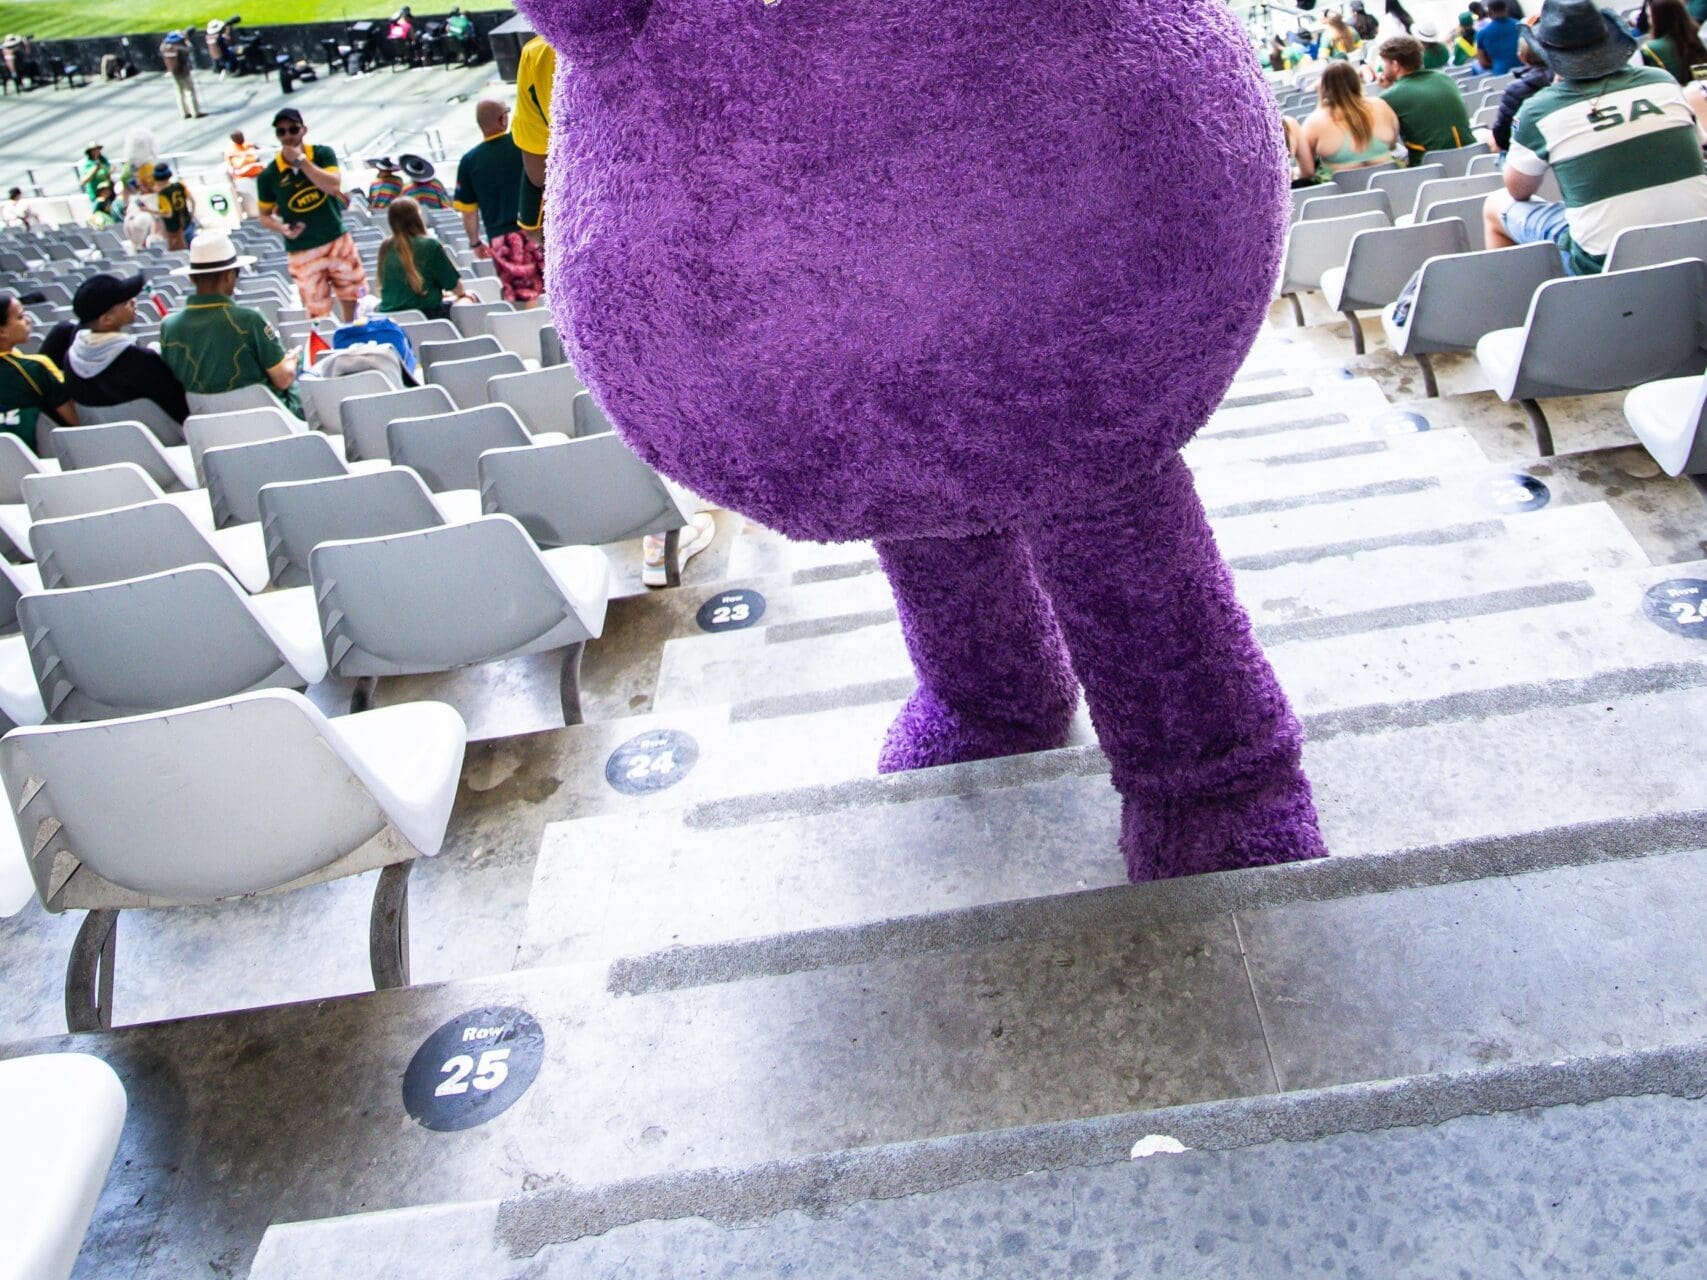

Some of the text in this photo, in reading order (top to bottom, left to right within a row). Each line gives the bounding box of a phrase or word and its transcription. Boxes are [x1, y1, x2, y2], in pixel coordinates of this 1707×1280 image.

[1587, 98, 1666, 132] SA
[711, 603, 750, 624] 23
[626, 750, 675, 779] 24
[462, 1025, 505, 1042] Row
[434, 1048, 511, 1097] 25
